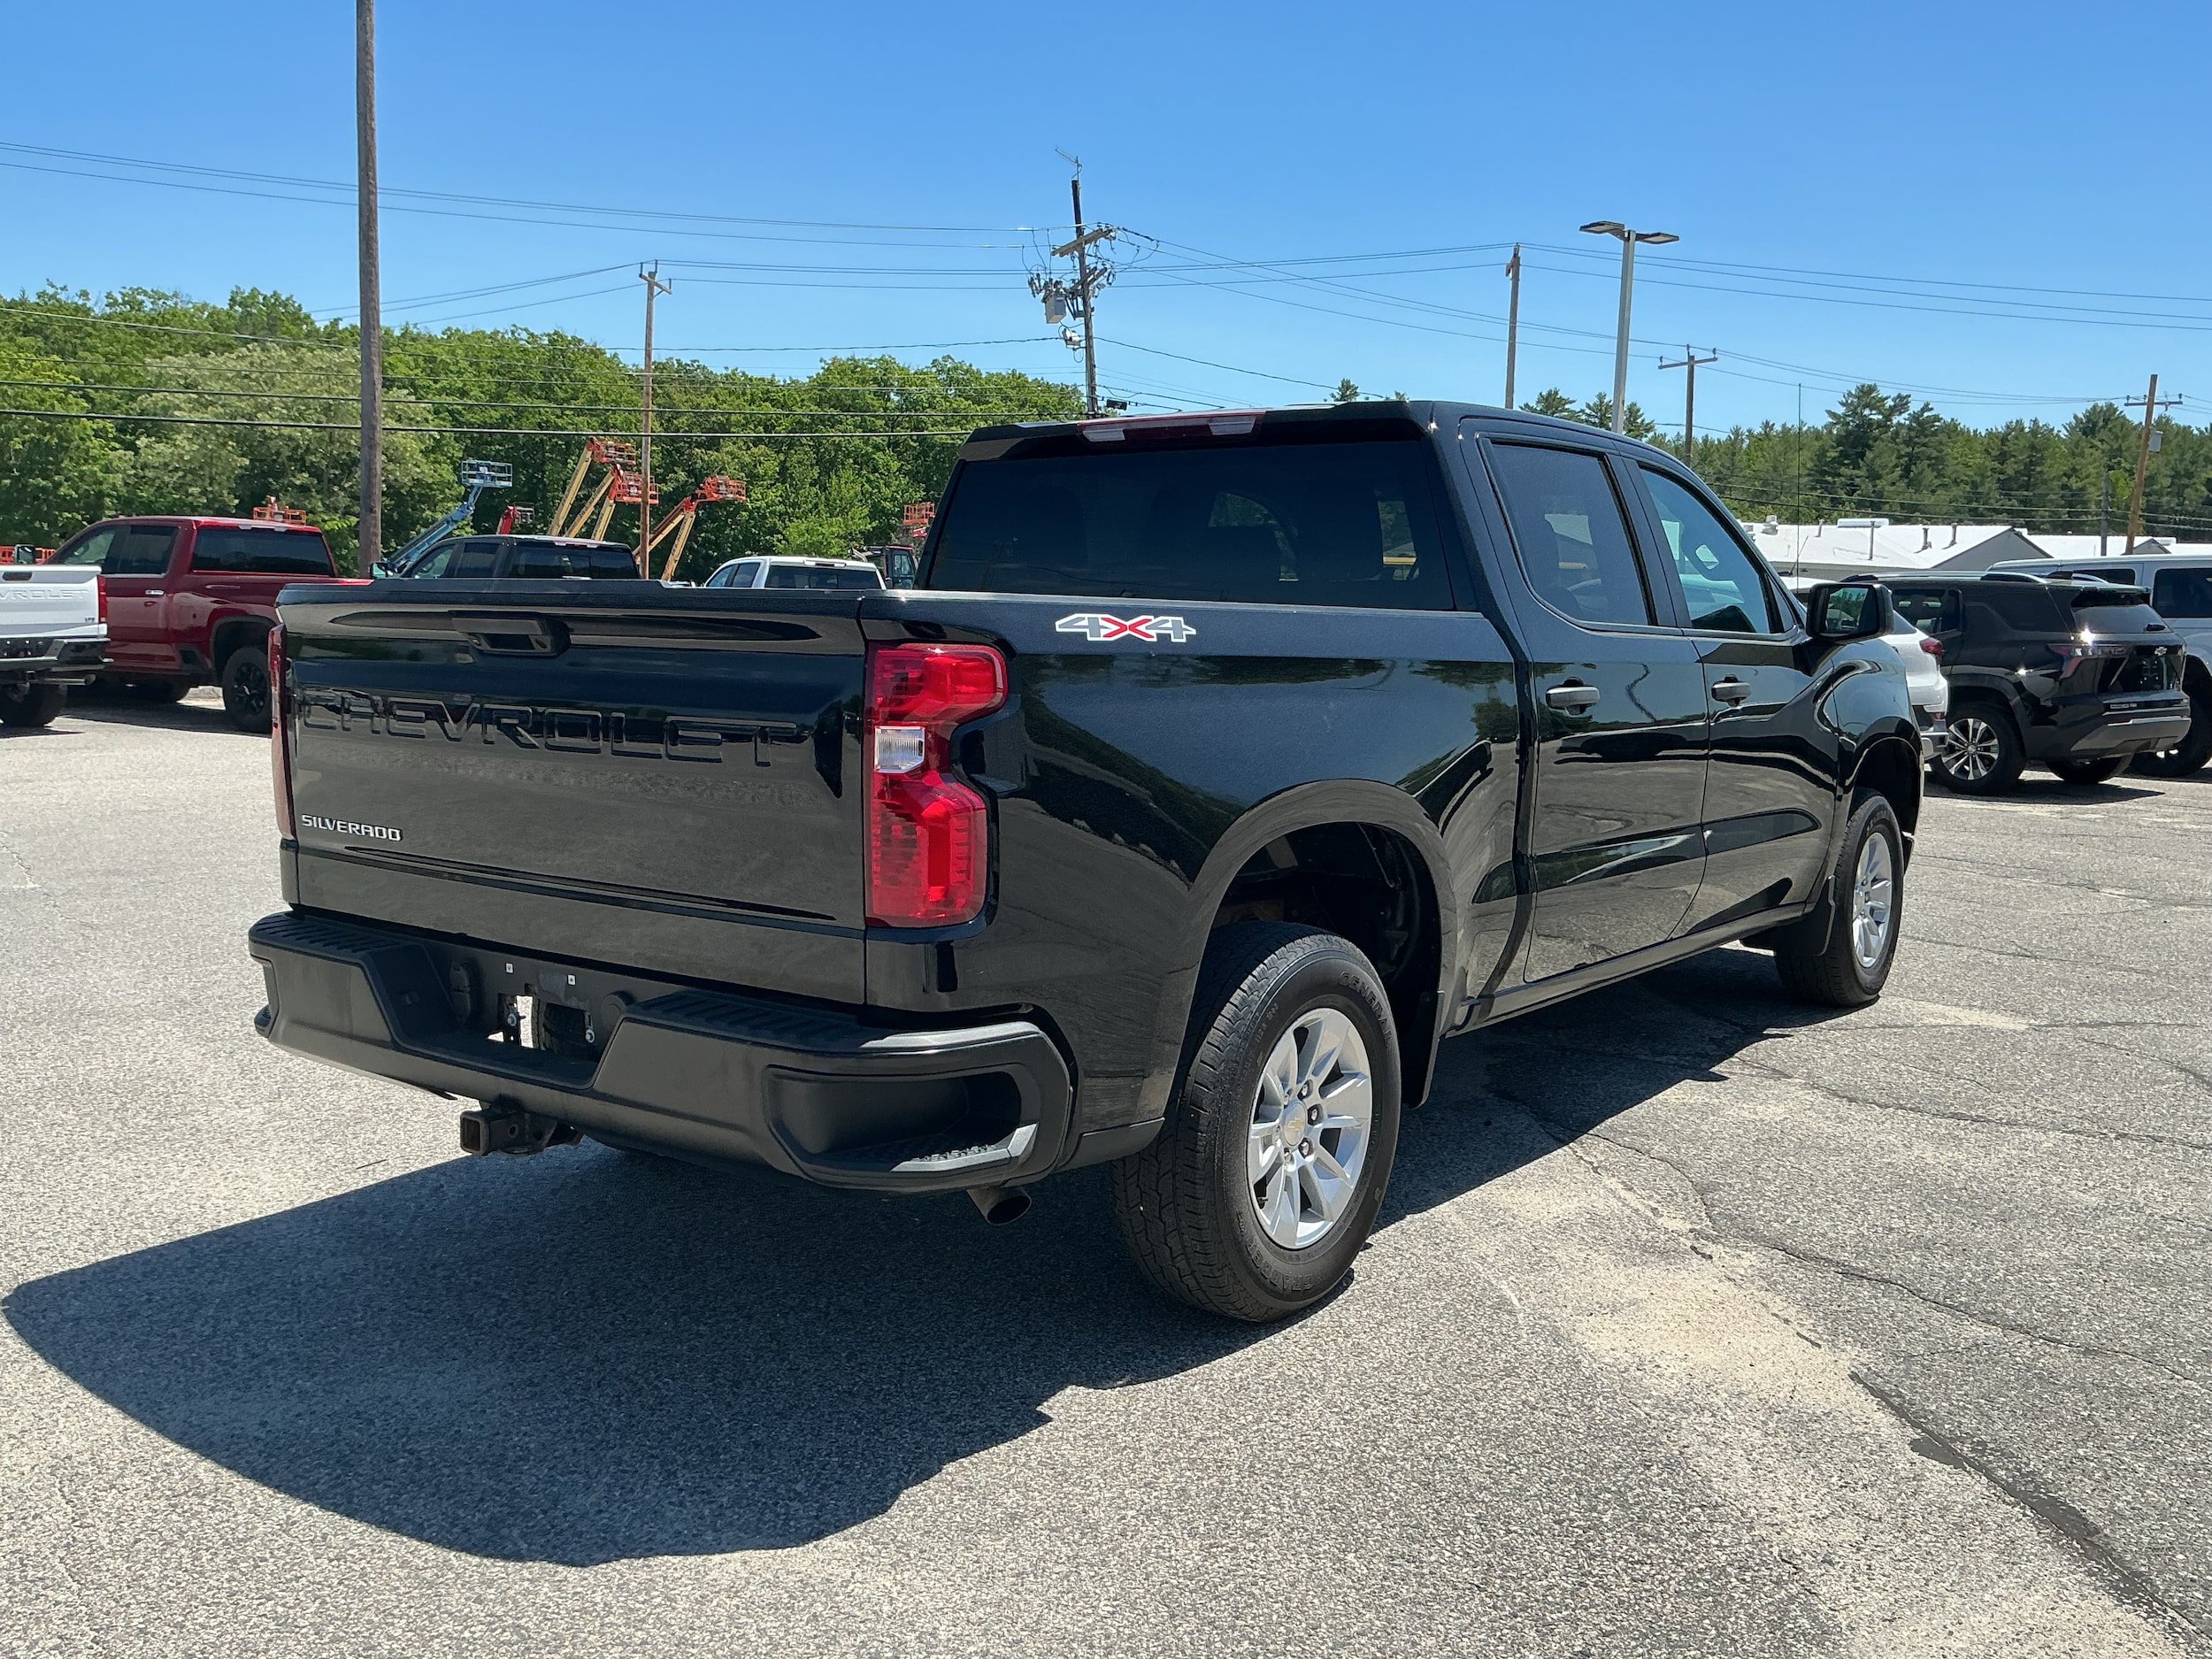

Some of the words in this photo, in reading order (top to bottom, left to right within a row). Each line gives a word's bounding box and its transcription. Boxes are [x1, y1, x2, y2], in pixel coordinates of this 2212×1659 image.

[303, 689, 797, 767] CHEVROLET
[302, 814, 403, 841] SILVERADO
[1339, 971, 1393, 1048] GENERAL
